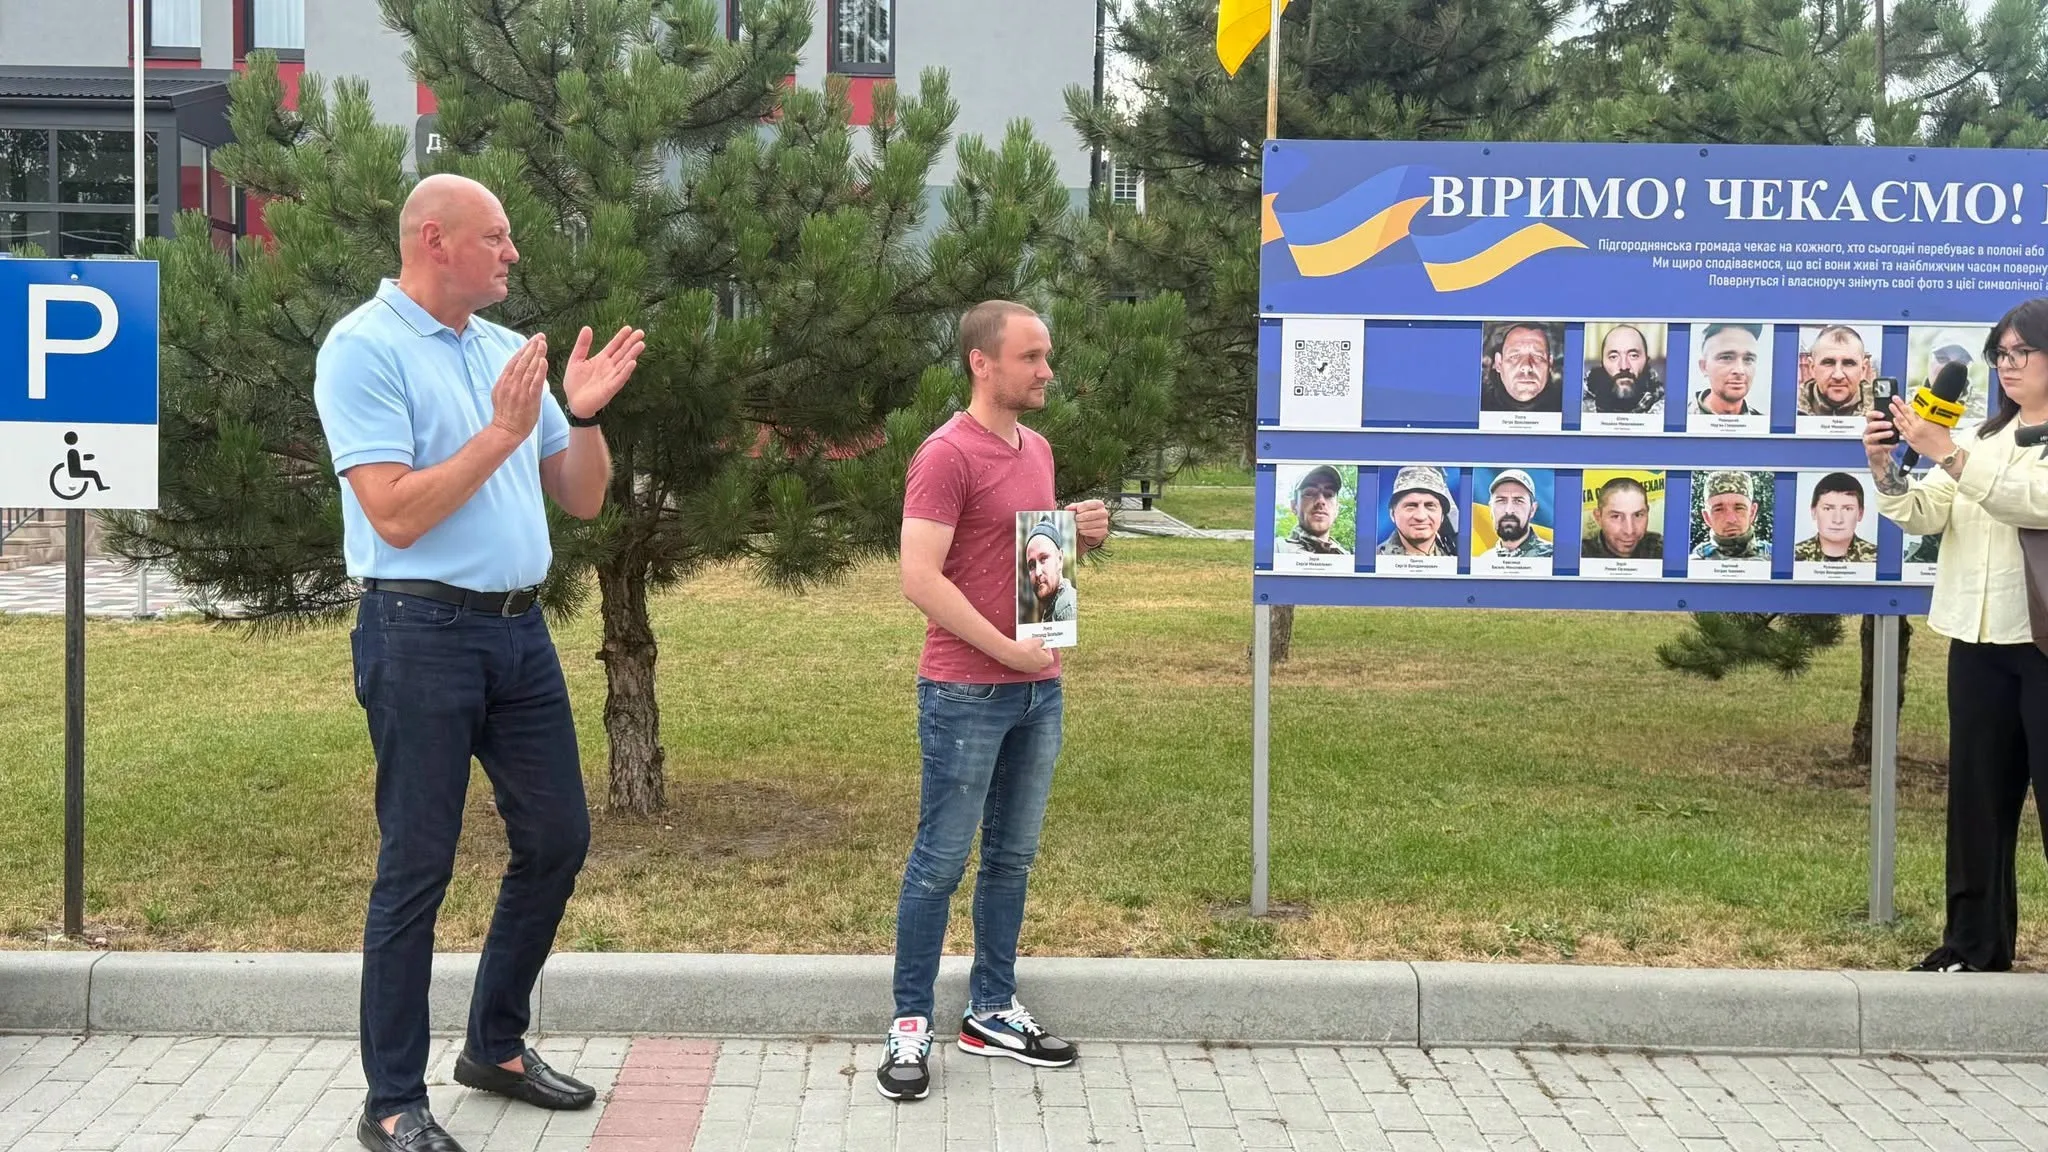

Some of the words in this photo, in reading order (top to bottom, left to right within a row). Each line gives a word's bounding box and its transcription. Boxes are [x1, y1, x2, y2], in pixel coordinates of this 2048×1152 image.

[1428, 176, 1687, 220] ВІРИМО!
[1704, 178, 2024, 225] ЧЕКАЄМО!
[1598, 238, 1692, 253] Підгороднянська
[1695, 241, 1742, 254] громада
[1744, 242, 1777, 253] чекає
[1779, 243, 1792, 253] на
[1795, 243, 1845, 255] кожного,
[1847, 243, 1866, 254] хто
[1868, 242, 1915, 256] сьогодні
[1918, 243, 1976, 258] перебуває
[1978, 246, 1984, 256] в
[1987, 244, 2022, 257] полоні
[2024, 244, 2045, 257] або
[1652, 256, 1669, 268] Ми
[1672, 258, 1702, 271] щиро
[1705, 257, 1783, 271] сподіваємося,
[1786, 260, 1803, 272] що
[1806, 258, 1822, 271] всі
[1824, 260, 1851, 271] вони
[1853, 259, 1879, 271] живі
[1881, 261, 1893, 271] та
[1896, 259, 1964, 272] найближчим
[1967, 263, 2000, 273] часом
[1709, 274, 1779, 288] Повернуться
[1781, 275, 1786, 287] і
[1788, 277, 1845, 290] власноруч
[1848, 276, 1889, 290] знімуть
[1892, 277, 1915, 289] свої
[1917, 276, 1944, 291] фото
[1946, 280, 1953, 289] з
[1955, 277, 1975, 290] цієї
[1978, 278, 2043, 291] символічної
[28, 283, 119, 399] P
